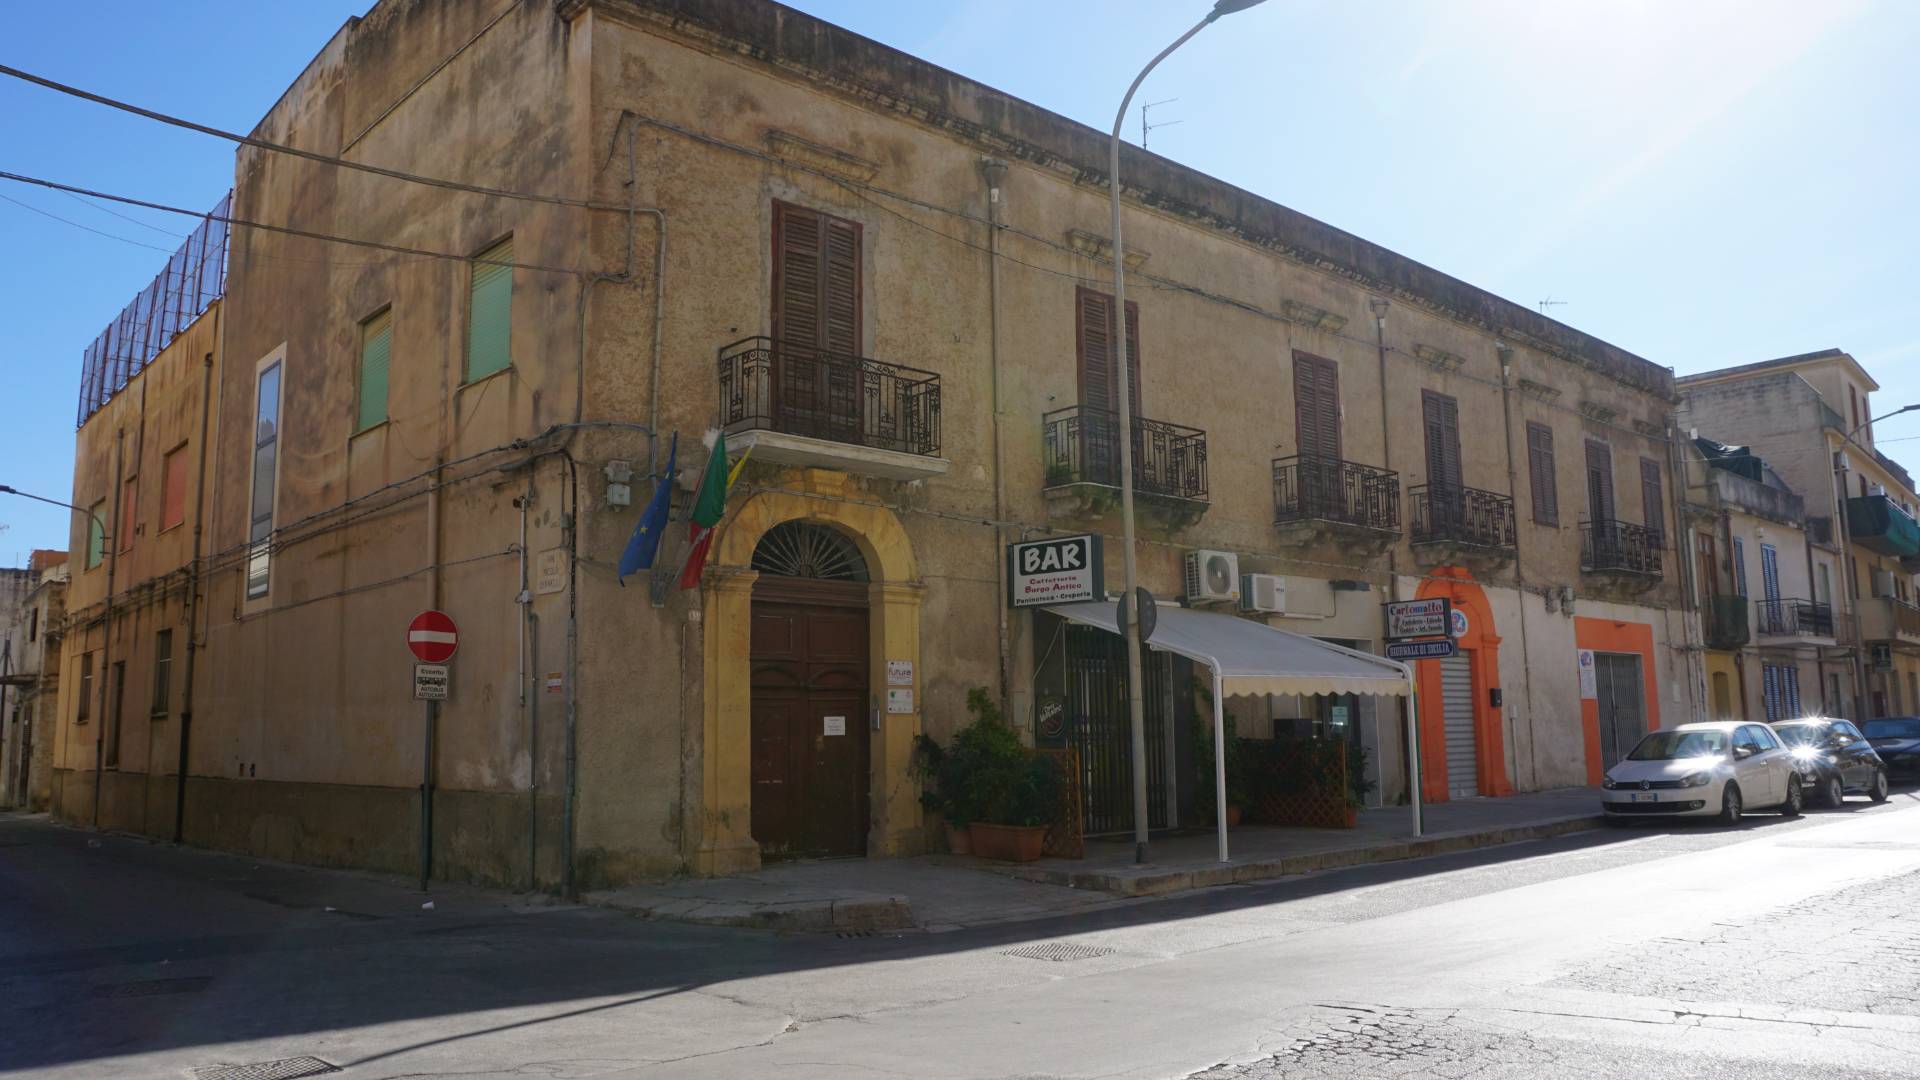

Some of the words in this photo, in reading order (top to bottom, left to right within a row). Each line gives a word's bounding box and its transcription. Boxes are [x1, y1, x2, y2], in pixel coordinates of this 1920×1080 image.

[1024, 543, 1081, 573] BAR
[1029, 576, 1077, 585] Caffetteria
[1024, 586, 1050, 594] Borgo
[1053, 583, 1082, 591] Antico
[1060, 591, 1091, 600] Creperia
[1389, 645, 1419, 657] GIORNALE
[1419, 644, 1426, 655] DI
[1427, 643, 1450, 654] SICILIA
